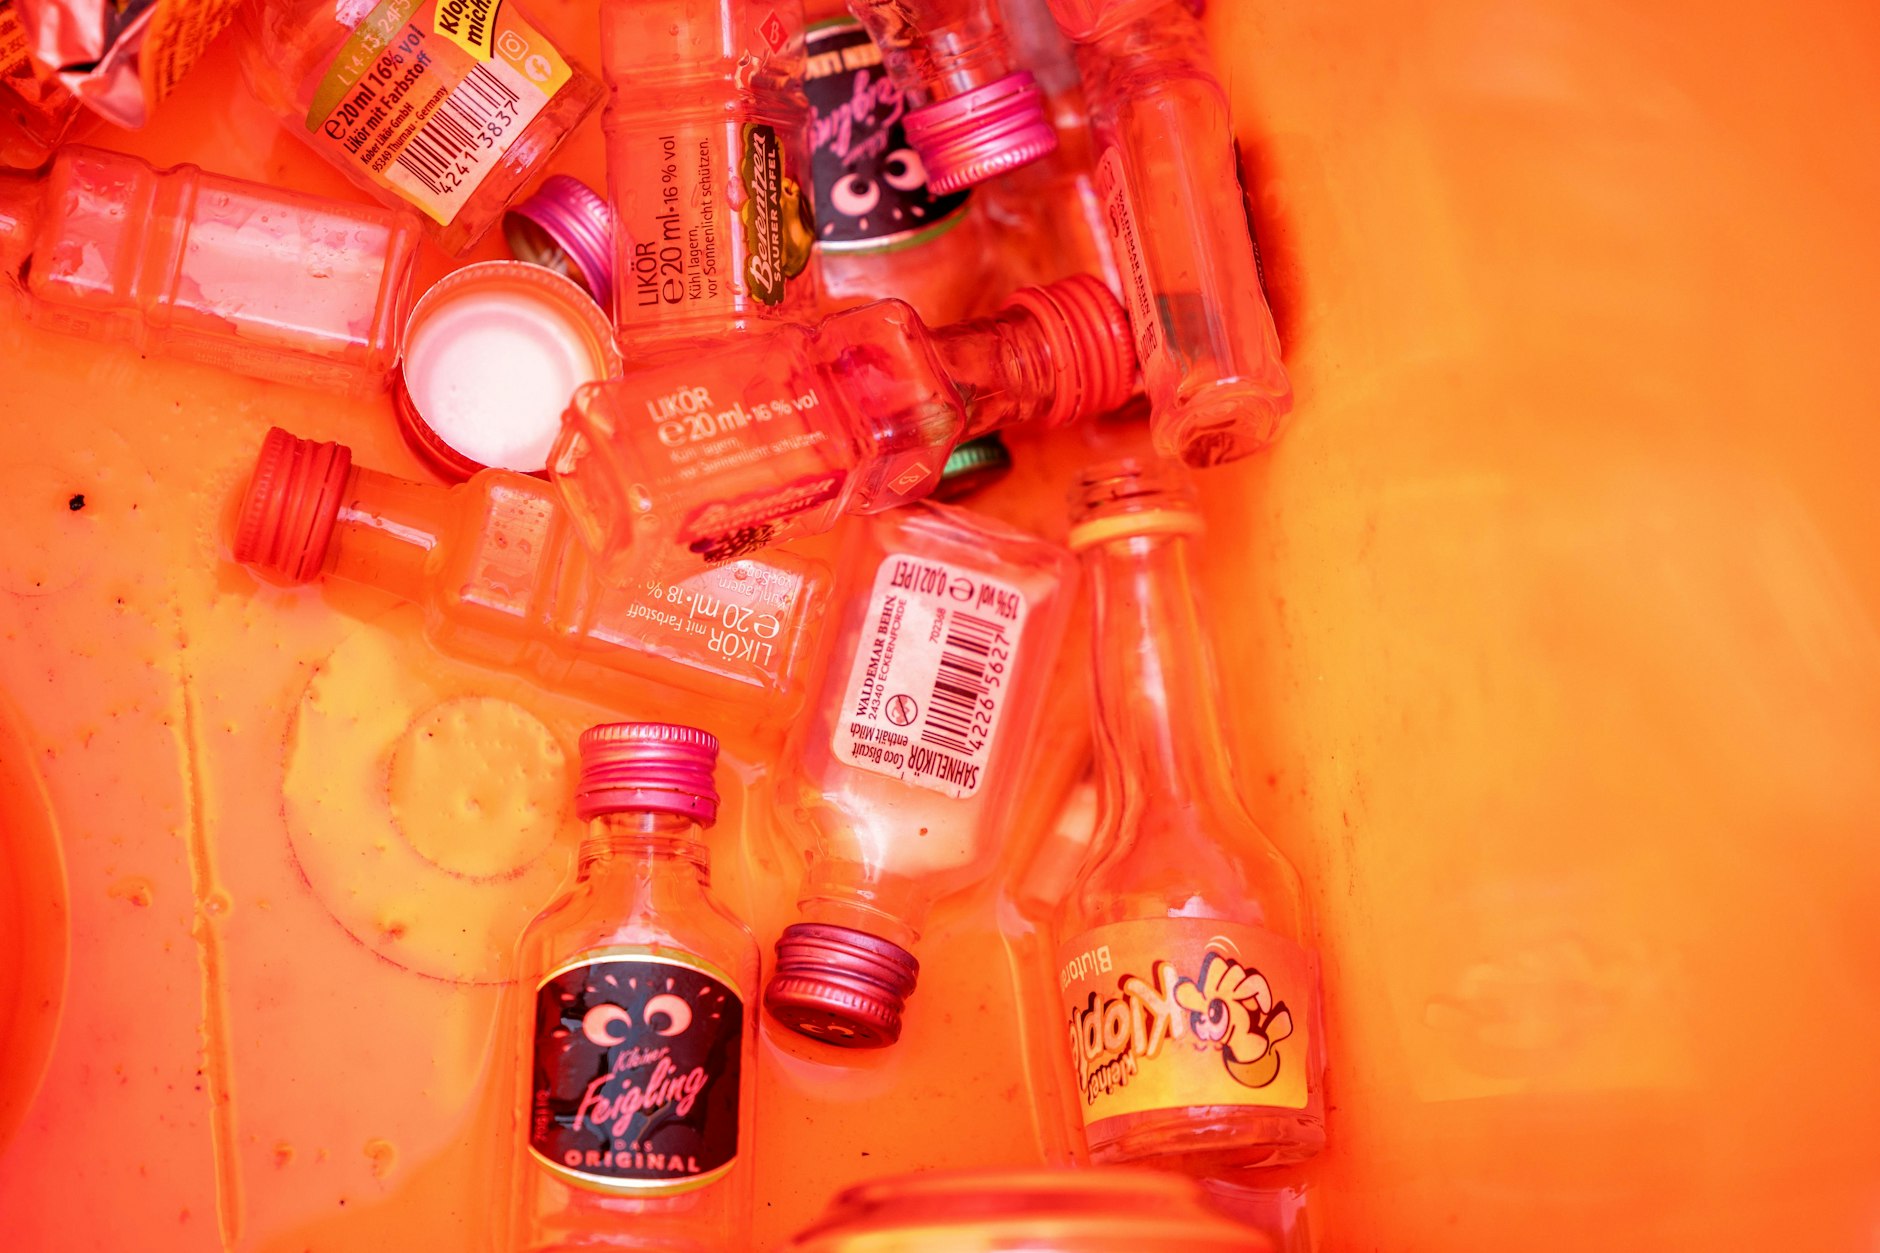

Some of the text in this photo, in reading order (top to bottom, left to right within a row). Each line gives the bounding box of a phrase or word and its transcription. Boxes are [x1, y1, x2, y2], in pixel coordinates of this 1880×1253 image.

[368, 50, 404, 88] 16%
[399, 23, 427, 55] vol
[343, 51, 433, 155] Likör mit Farbstoff
[371, 85, 449, 174] 95349 Thurnau Germany
[360, 101, 415, 166] Kober Likör GmbH
[438, 99, 519, 195] 4241 3837
[659, 135, 675, 162] vol
[662, 166, 677, 182] %
[699, 137, 718, 298] vor Sonnenlicht schützen.
[750, 132, 774, 294] Berentzen
[768, 148, 782, 282] SAURER APFEL
[631, 241, 659, 307] LIKÖR
[688, 225, 703, 300] Kühl lagern,
[1117, 188, 1151, 314] WALDEMAR BEHN
[646, 386, 714, 424] LIKÖR
[772, 397, 790, 416] %
[792, 388, 819, 410] vol
[717, 574, 755, 597] lagern,
[891, 561, 911, 589] PET
[921, 567, 949, 597] 0,02
[976, 583, 996, 610] vol
[929, 607, 947, 644] 702368
[998, 589, 1020, 620] 15%
[626, 602, 773, 666] LIKÖR mit Farbstoff
[856, 594, 897, 717] WALDEMAR BEHN
[868, 684, 885, 720] 24340
[968, 633, 1010, 751] 4226 5627
[850, 722, 908, 747] enthält Milch
[852, 742, 980, 790] SAHNELIKÖR Coco Biscuit
[573, 1056, 708, 1137] Feigling
[1088, 1051, 1137, 1105] kleiner
[564, 1149, 701, 1173] ORIGINAL
[615, 1139, 653, 1151] DAS
